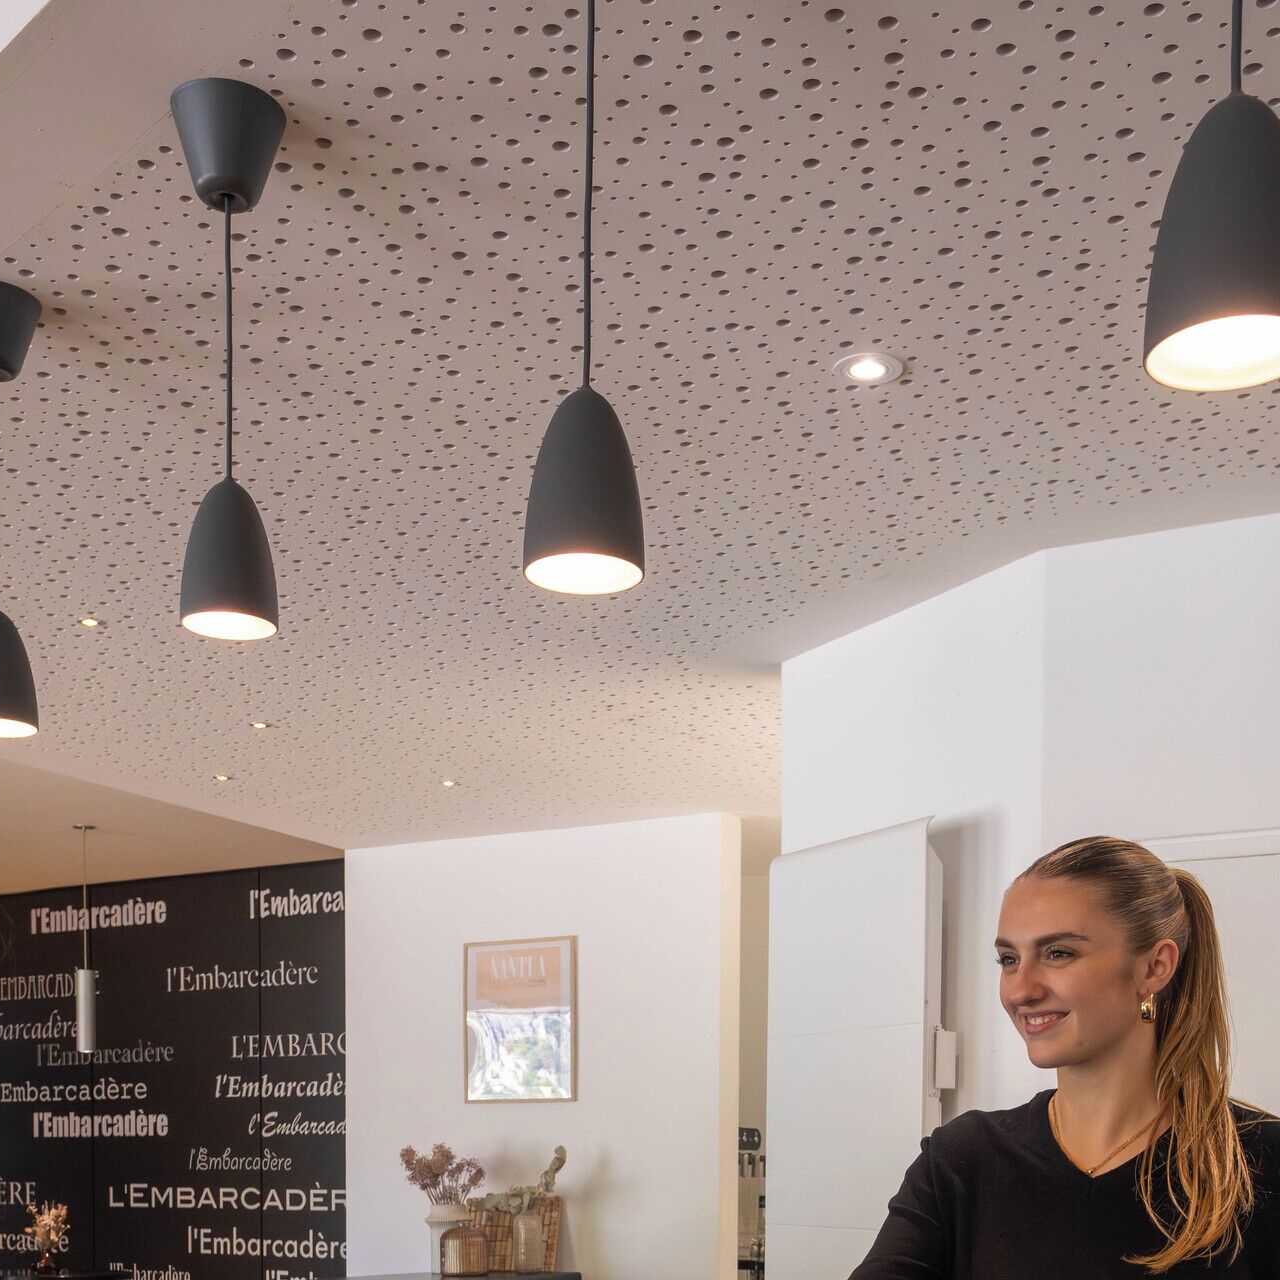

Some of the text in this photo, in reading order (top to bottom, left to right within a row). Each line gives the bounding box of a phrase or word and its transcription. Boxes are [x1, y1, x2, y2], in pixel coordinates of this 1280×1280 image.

[30, 896, 168, 935] l'Embarcadère
[166, 960, 319, 993] l'Embarcadère
[33, 1110, 169, 1138] l'Embarcadère
[189, 1147, 293, 1172] l'Embarcadère
